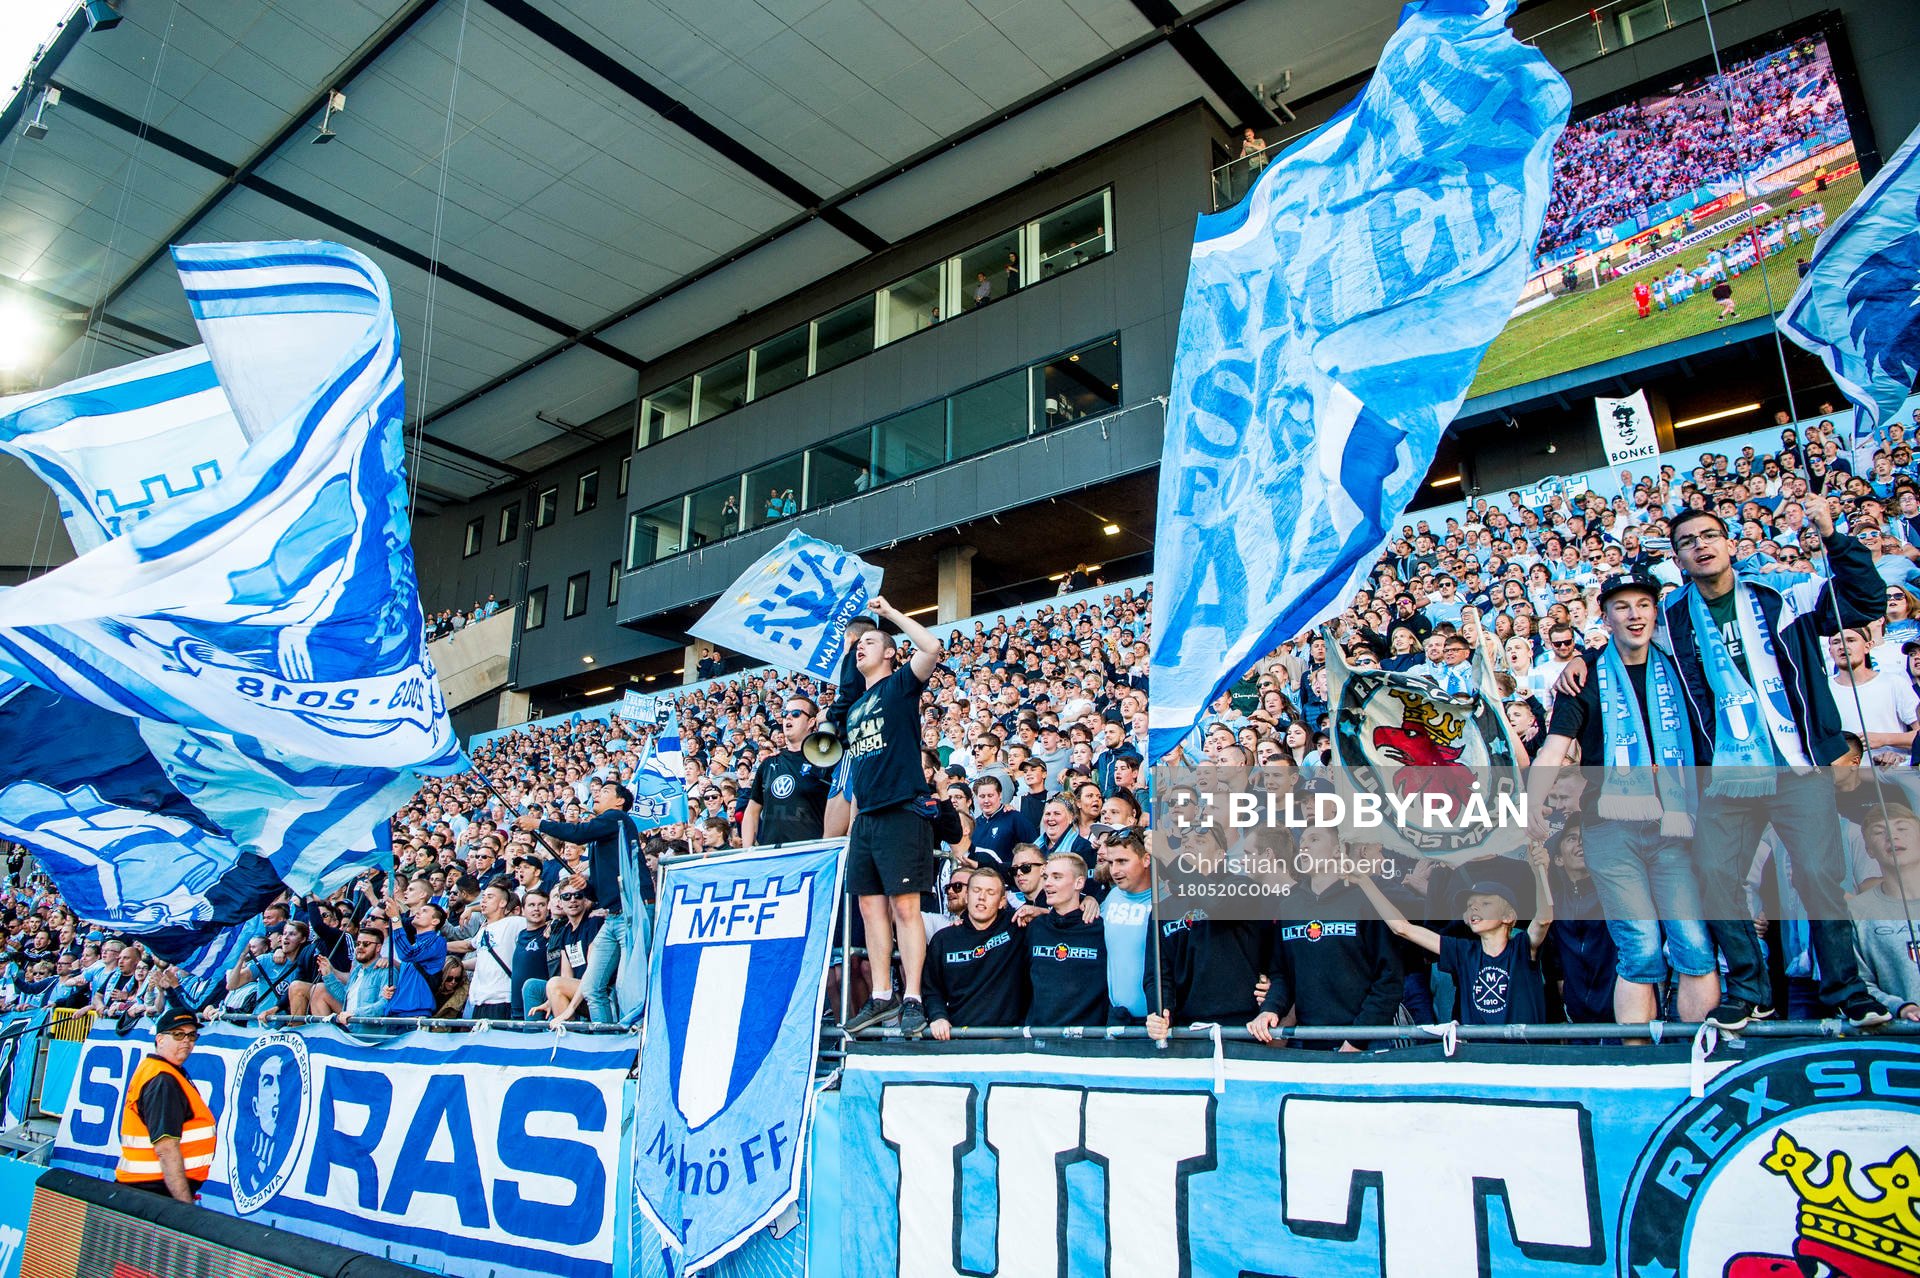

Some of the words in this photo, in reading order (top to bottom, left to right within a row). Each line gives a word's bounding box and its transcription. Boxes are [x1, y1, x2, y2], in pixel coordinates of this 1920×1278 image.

[1611, 445, 1655, 462] BONKE
[1304, 779, 1317, 790] H
[270, 1034, 303, 1054] MALMÖ
[1655, 1075, 1790, 1200] REX
[740, 1120, 789, 1185] FF
